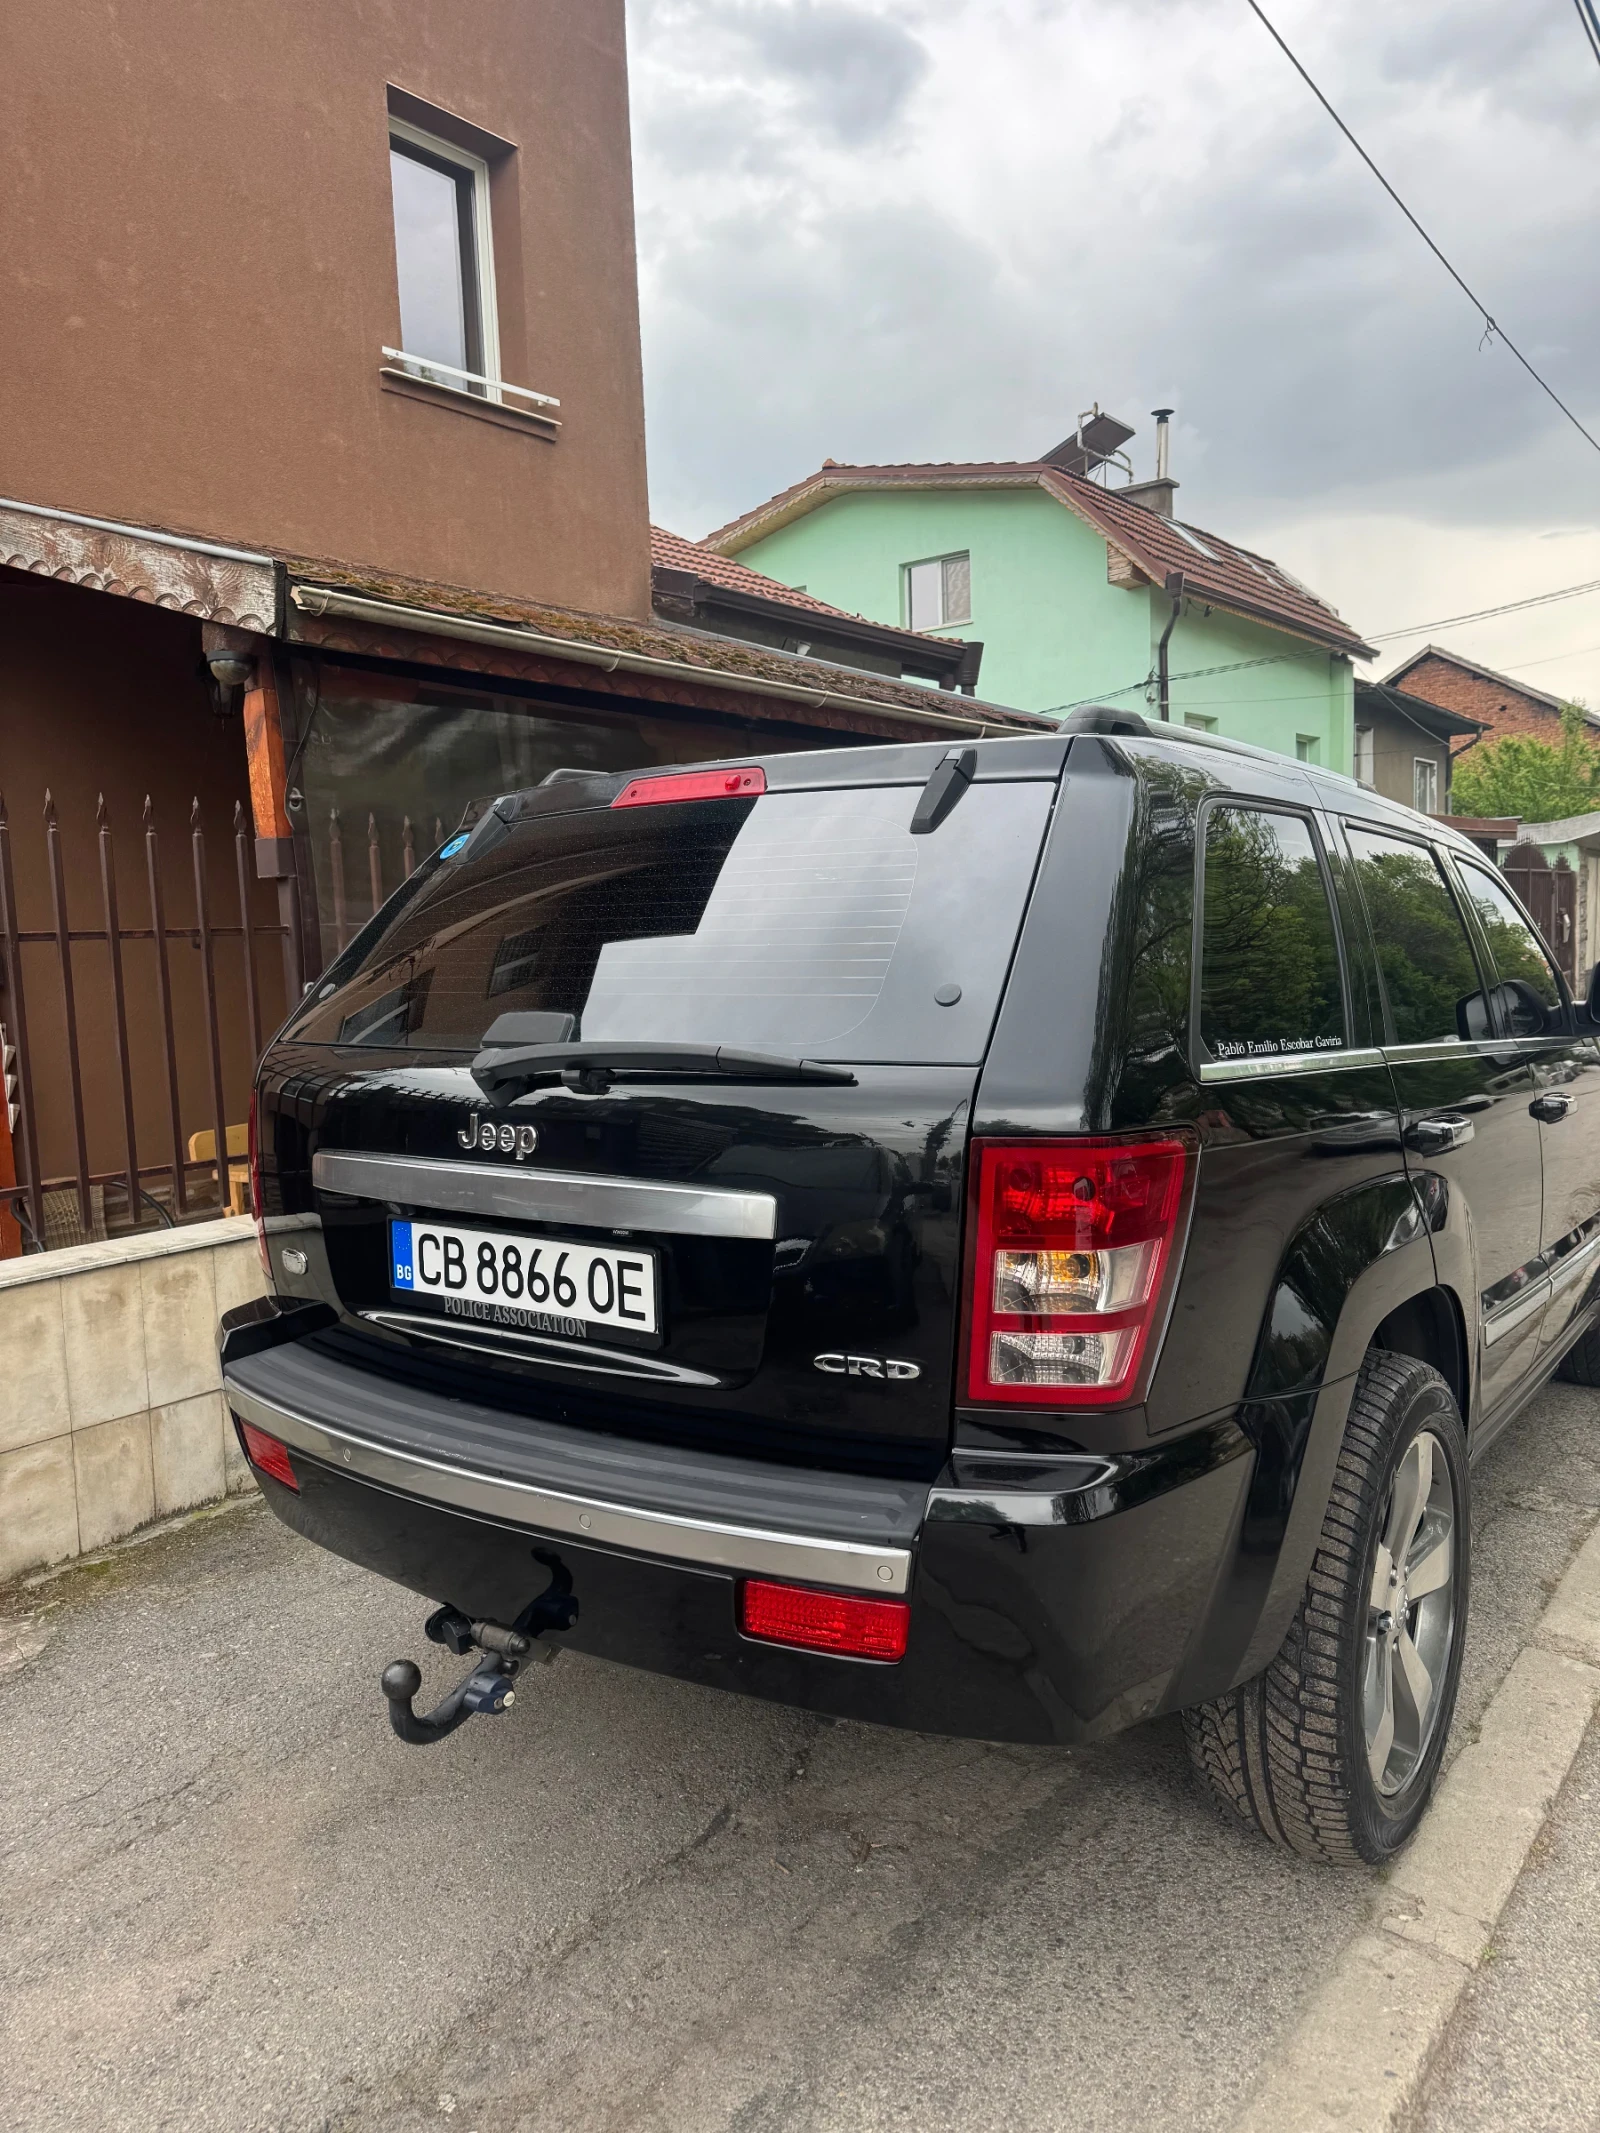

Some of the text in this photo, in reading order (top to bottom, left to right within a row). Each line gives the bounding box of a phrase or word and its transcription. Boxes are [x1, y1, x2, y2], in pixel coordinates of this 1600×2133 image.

[1247, 1039, 1279, 1054] Emilio
[1280, 1037, 1314, 1051] Escobar
[1315, 1035, 1343, 1048] Gaviria
[457, 1112, 539, 1160] Jeep
[396, 1264, 412, 1281] BG
[418, 1233, 467, 1289] CB
[477, 1241, 577, 1308] 8866
[443, 1296, 588, 1339] POLICE ASSOCIATION
[813, 1353, 921, 1380] CRD
